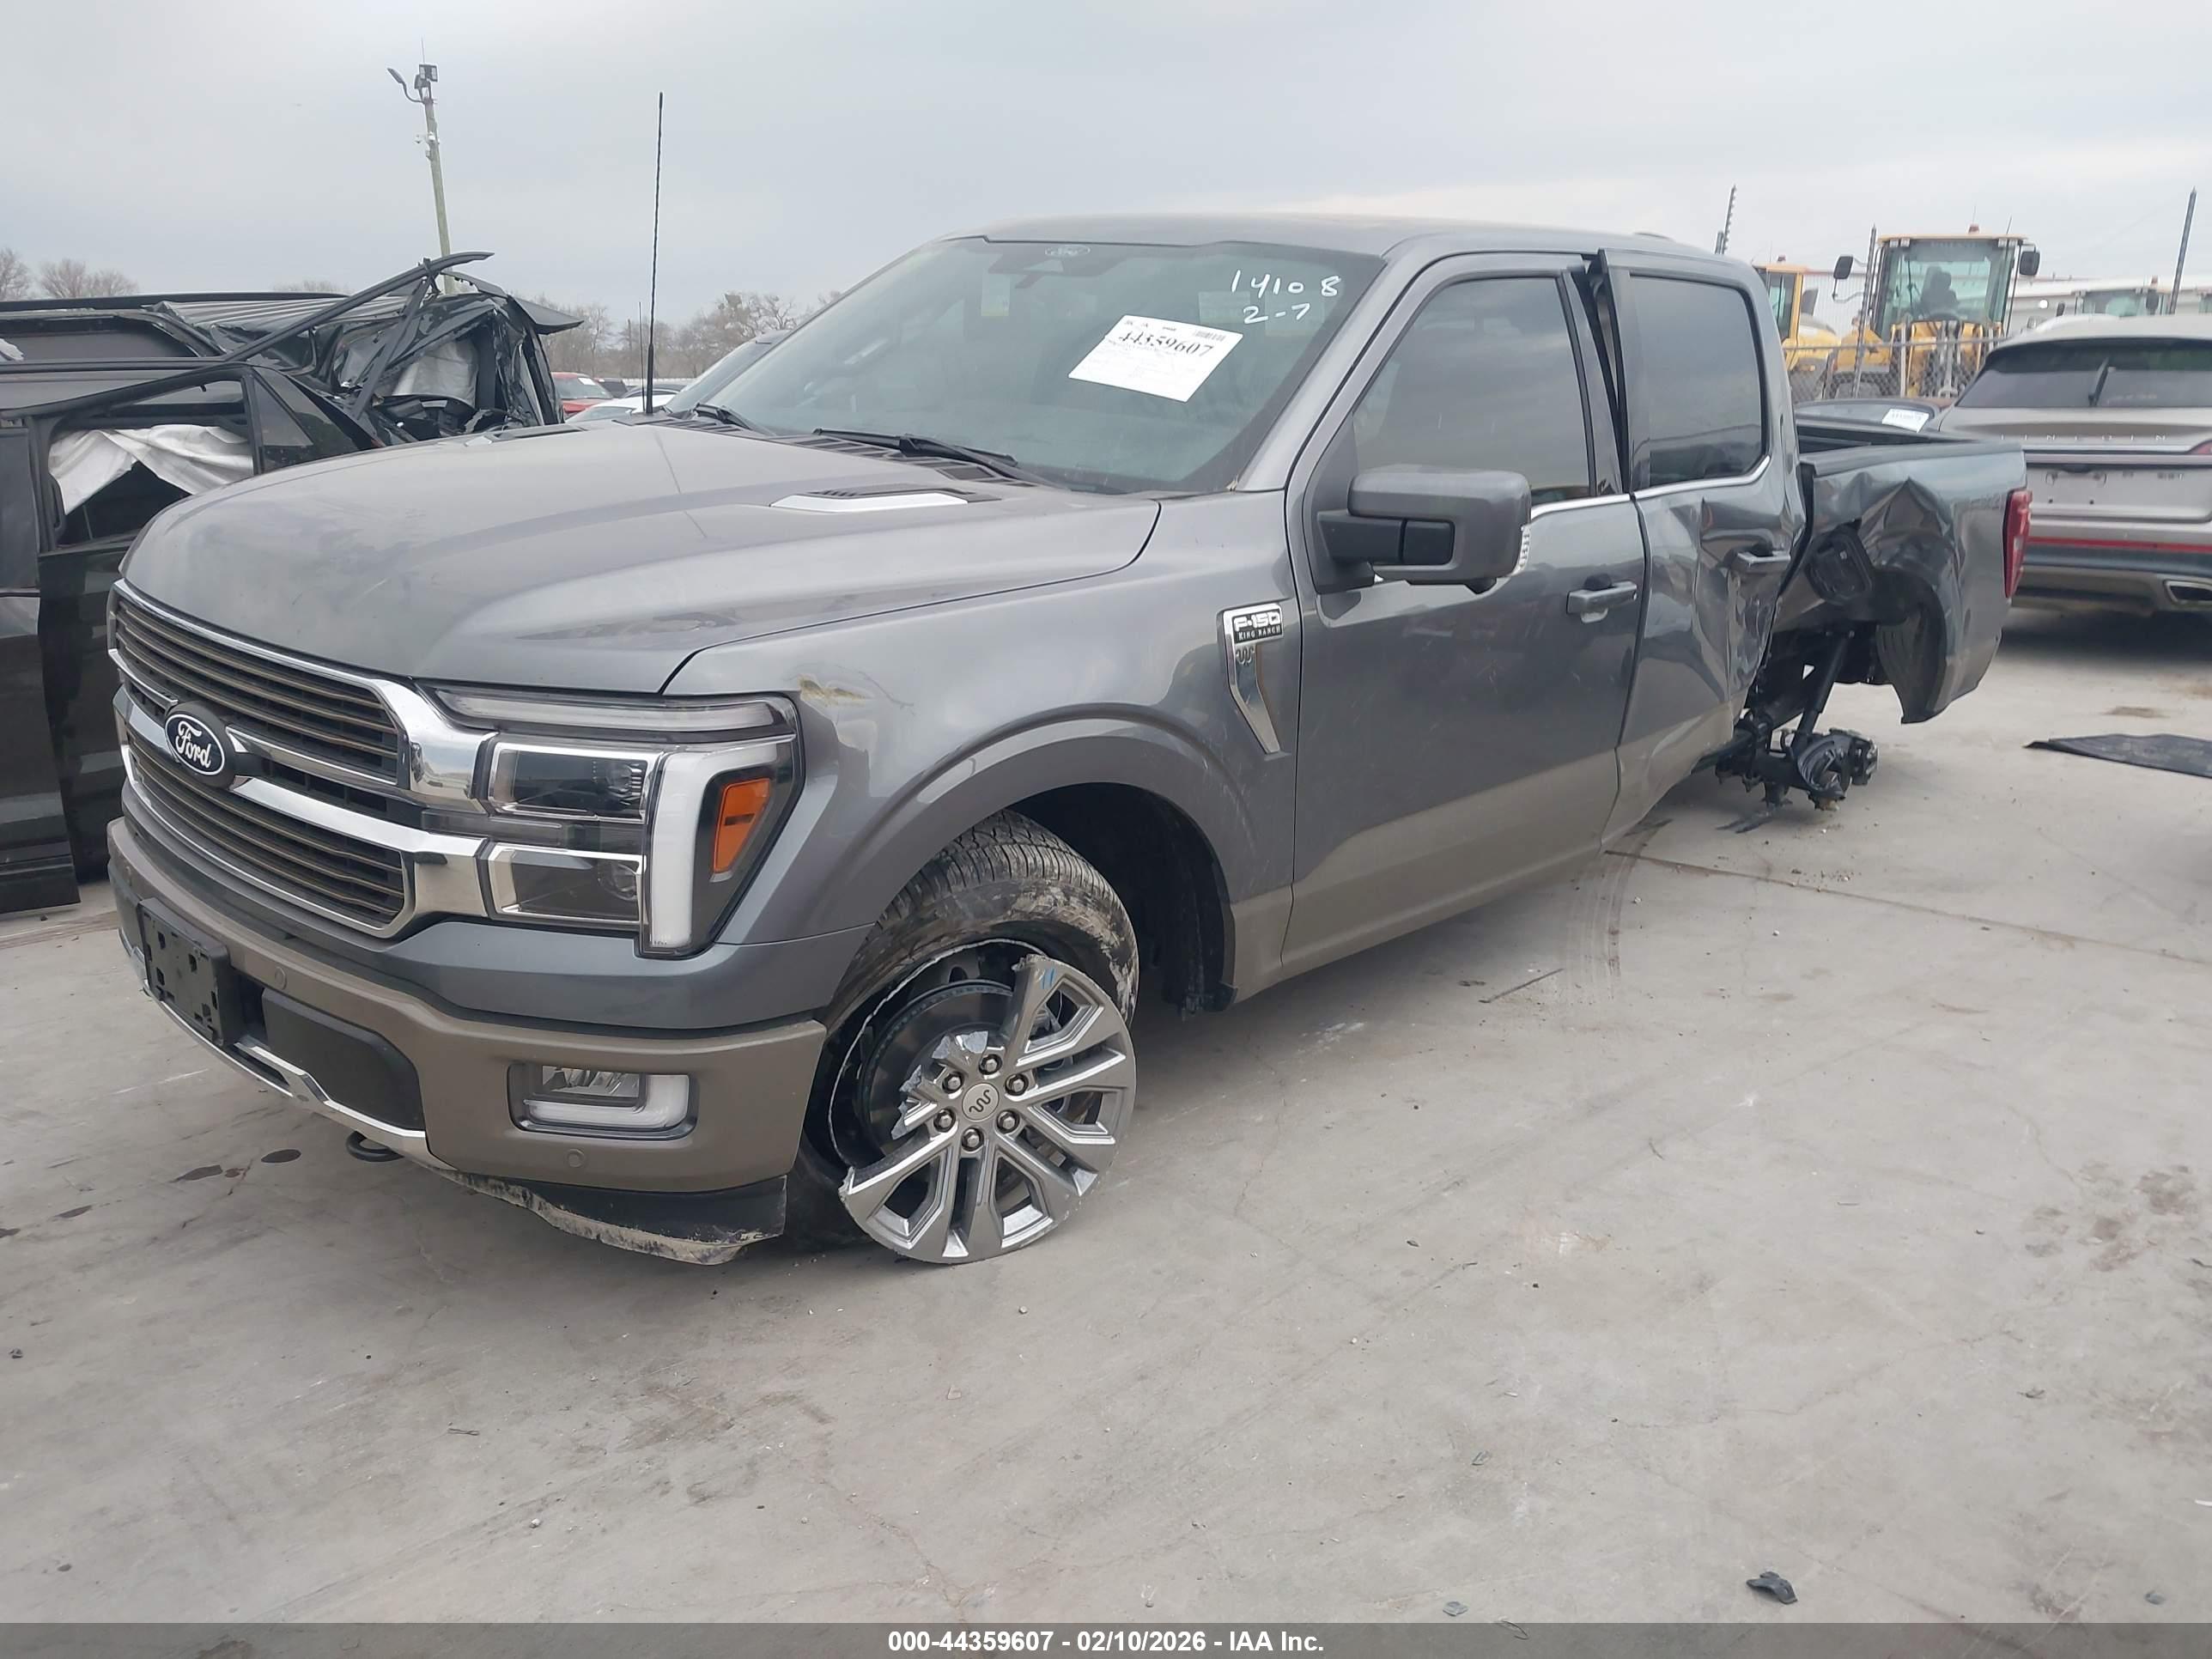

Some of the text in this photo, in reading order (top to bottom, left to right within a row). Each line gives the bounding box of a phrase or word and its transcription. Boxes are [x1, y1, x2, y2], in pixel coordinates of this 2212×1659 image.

[1243, 302, 1311, 325] 2-7
[1118, 331, 1214, 357] 44359607
[1233, 611, 1282, 632] F-150
[1238, 623, 1281, 641] KING RANCH
[175, 720, 213, 769] Ford
